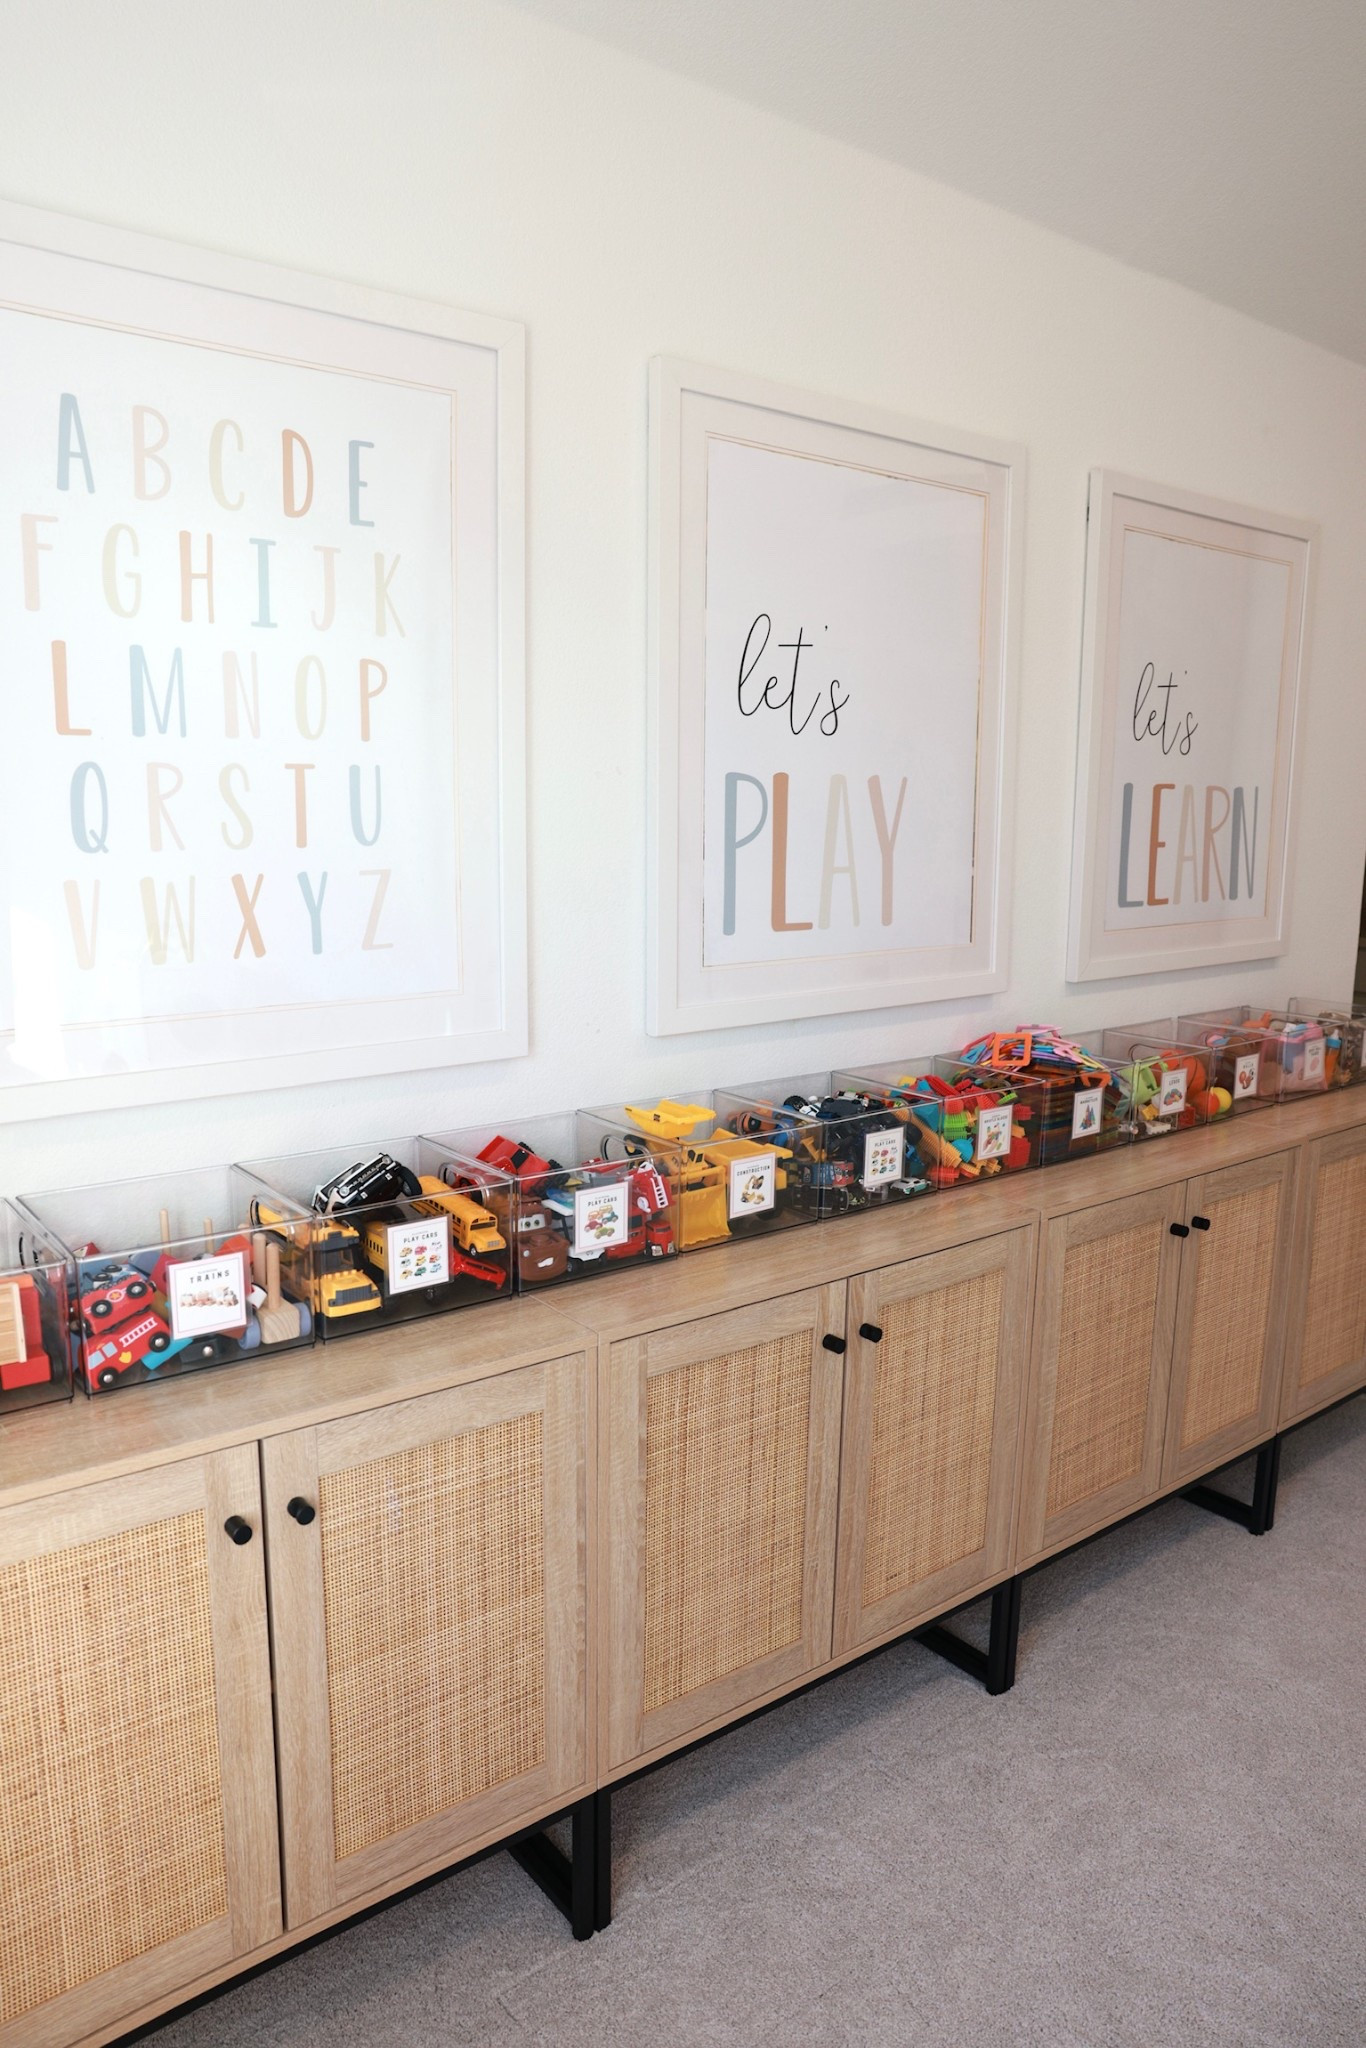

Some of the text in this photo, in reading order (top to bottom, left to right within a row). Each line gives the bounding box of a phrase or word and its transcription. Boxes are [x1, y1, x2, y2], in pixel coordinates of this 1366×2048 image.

[737, 613, 850, 737] let's
[1132, 661, 1199, 756] let's
[722, 771, 908, 937] PLAY
[1116, 782, 1260, 909] LEARN
[737, 1165, 770, 1176] CONSTRUCTION
[587, 1199, 602, 1207] PLAY
[603, 1196, 617, 1204] CARS
[421, 1231, 438, 1240] CARS
[190, 1269, 230, 1284] TRAINS
